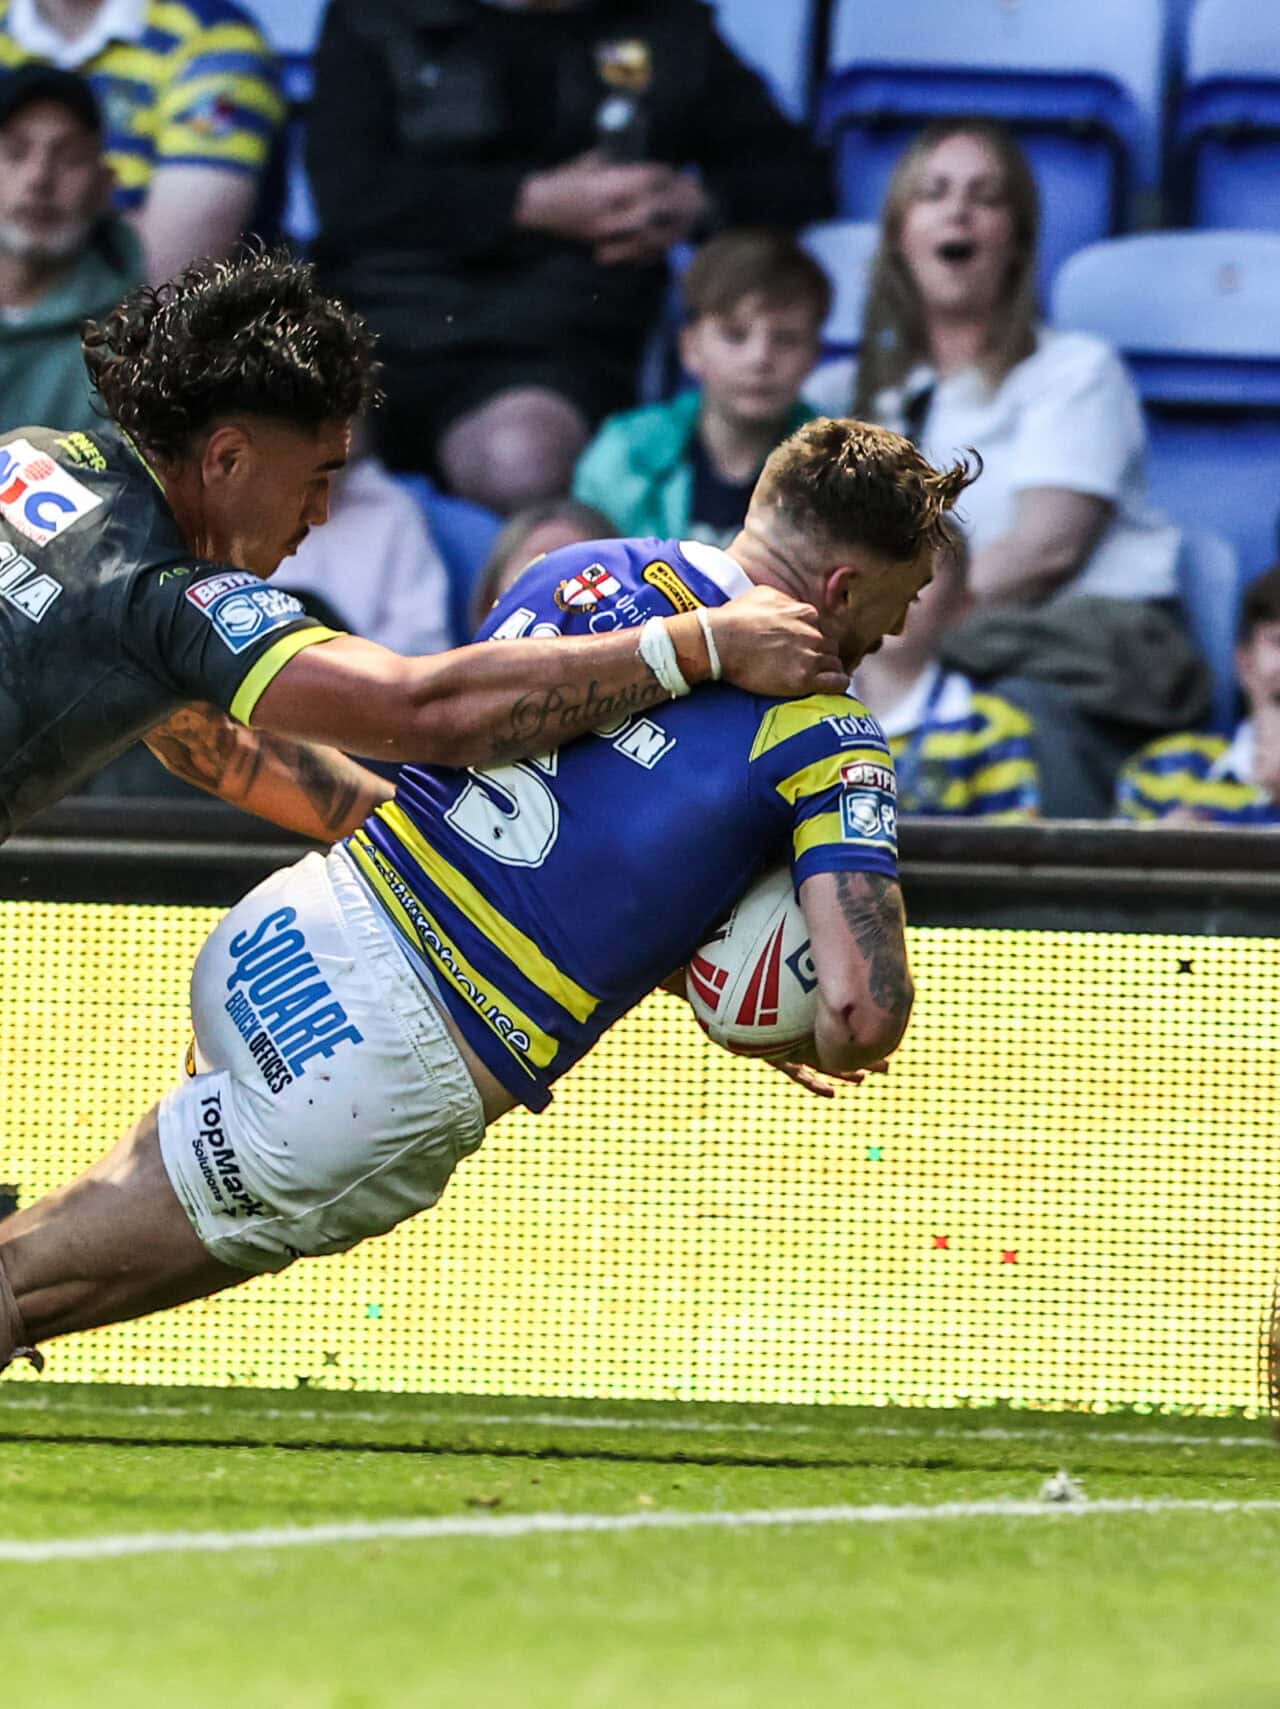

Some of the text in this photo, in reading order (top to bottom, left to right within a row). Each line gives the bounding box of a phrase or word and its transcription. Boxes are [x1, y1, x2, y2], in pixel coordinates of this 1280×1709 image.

[225, 989, 294, 1095] BRICK OFFICES
[226, 906, 364, 1077] SQUARE
